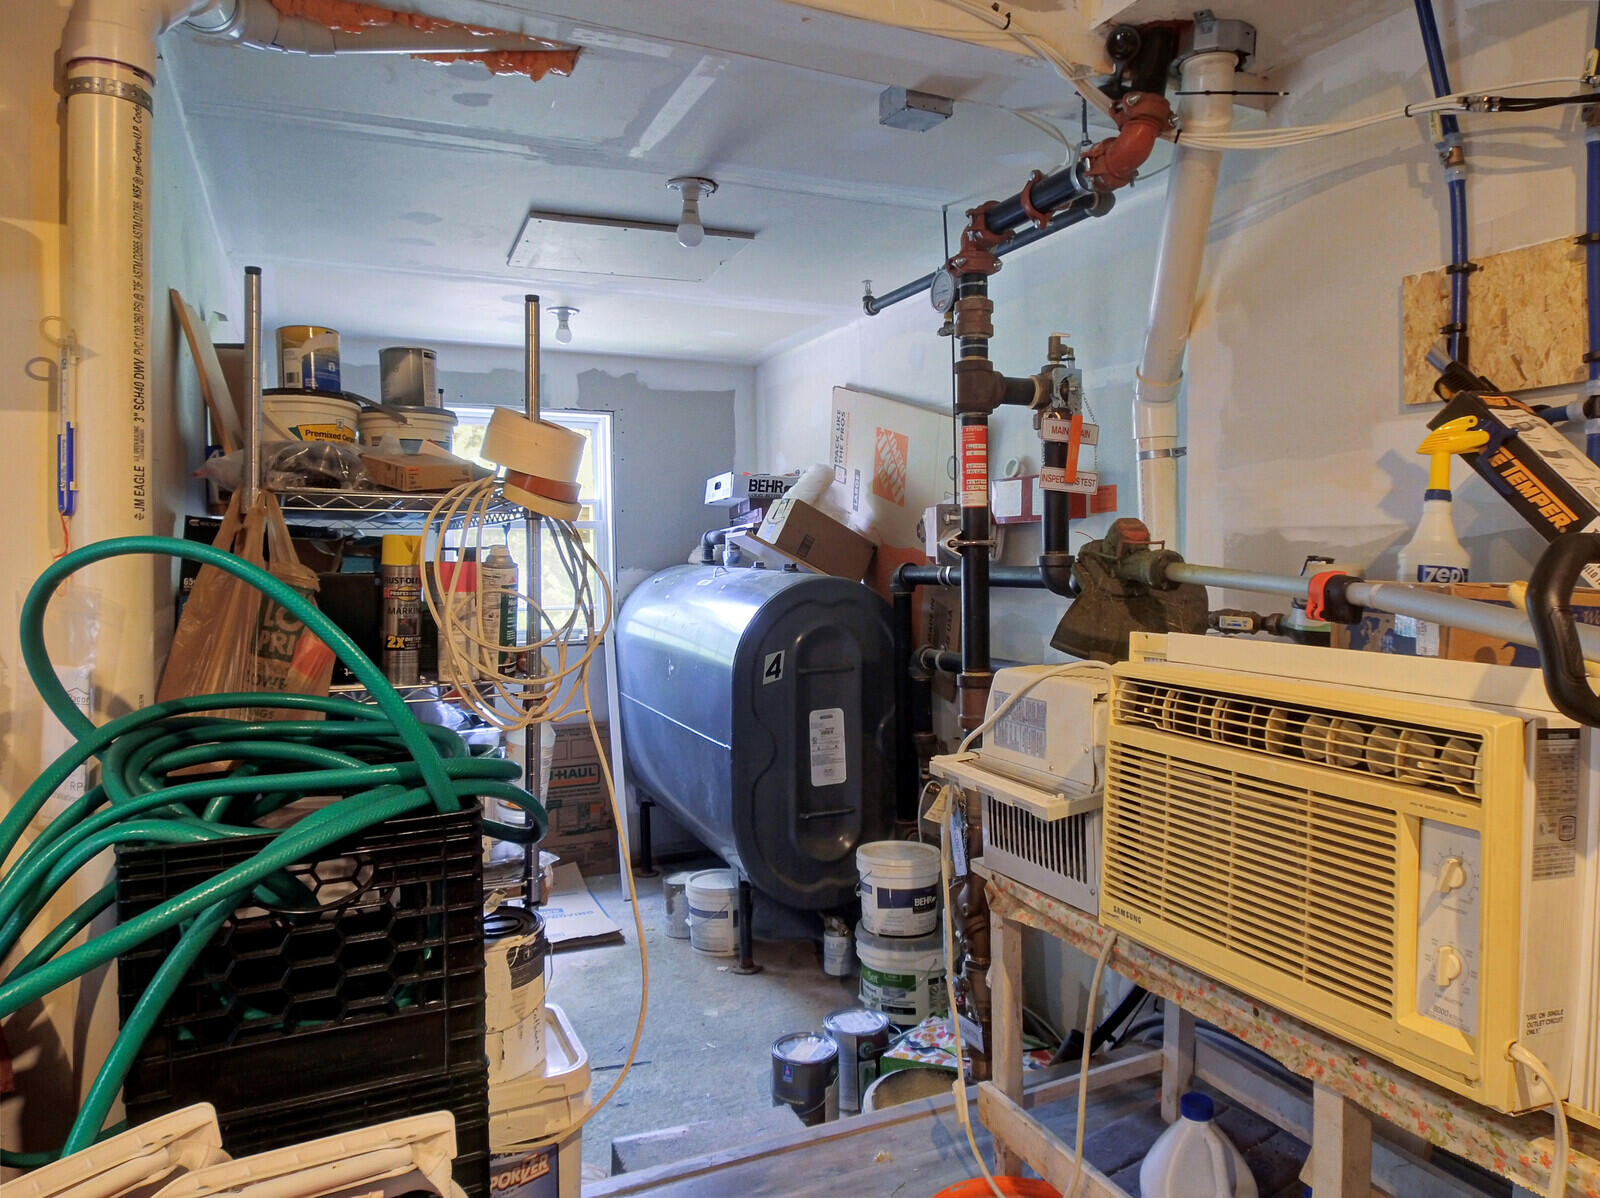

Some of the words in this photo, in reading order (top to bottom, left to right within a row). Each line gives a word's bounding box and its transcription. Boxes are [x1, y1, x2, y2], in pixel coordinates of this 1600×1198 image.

[134, 342, 144, 356] PVC
[134, 358, 144, 380] DWV
[134, 382, 144, 411] SCH40
[305, 430, 341, 440] Premixed
[1051, 426, 1069, 436] MAIN
[134, 466, 144, 496] EAGLE
[749, 479, 784, 493] BEHR
[1081, 477, 1096, 487] TEST
[1500, 458, 1578, 531] TEMPER
[134, 500, 144, 512] JM
[766, 654, 782, 679] 4
[914, 898, 931, 907] BEHR
[1114, 906, 1142, 924] SAMSUNG
